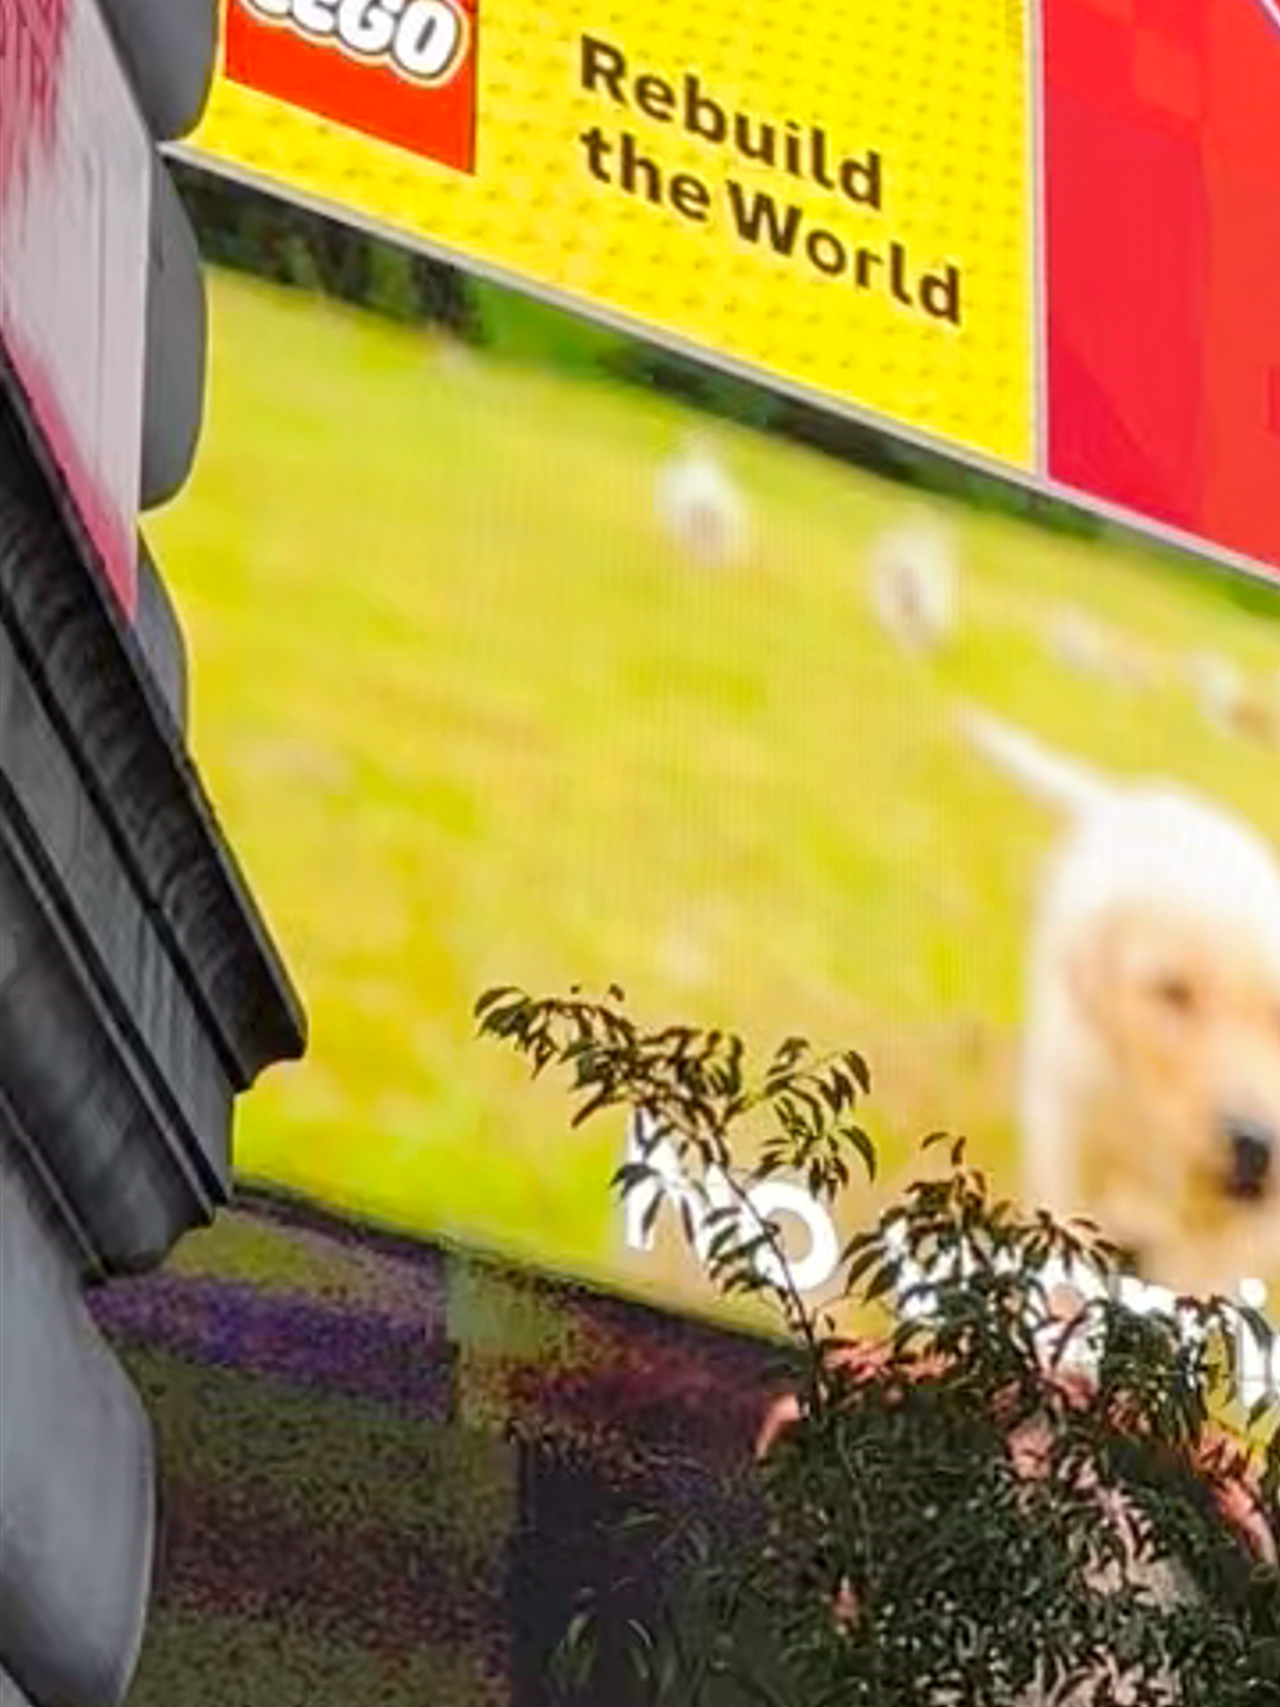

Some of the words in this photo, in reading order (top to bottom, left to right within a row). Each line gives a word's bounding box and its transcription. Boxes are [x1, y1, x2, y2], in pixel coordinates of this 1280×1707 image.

[580, 33, 885, 210] Rebuild
[581, 126, 711, 224] the
[727, 179, 962, 327] World
